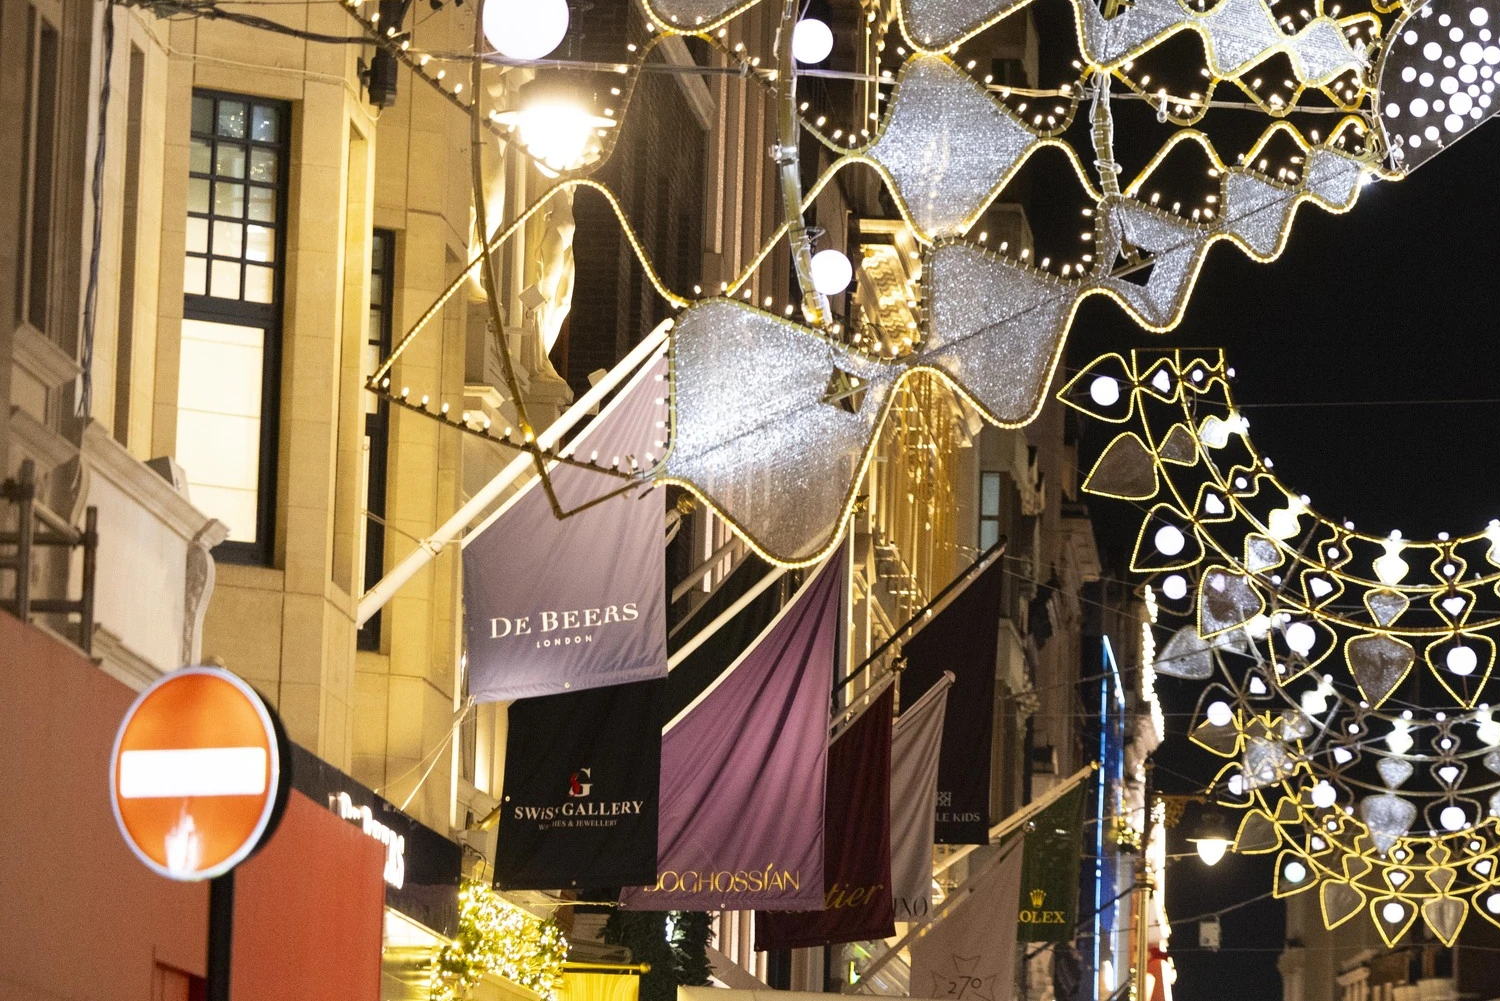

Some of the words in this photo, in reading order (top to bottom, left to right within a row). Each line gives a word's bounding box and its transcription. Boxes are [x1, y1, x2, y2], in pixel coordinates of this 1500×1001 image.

[489, 616, 532, 639] DE
[539, 602, 639, 633] BEERS
[536, 635, 593, 648] LONDON
[561, 800, 643, 816] GALLERY
[953, 812, 981, 822] KIDS
[1017, 910, 1066, 924] OLEX
